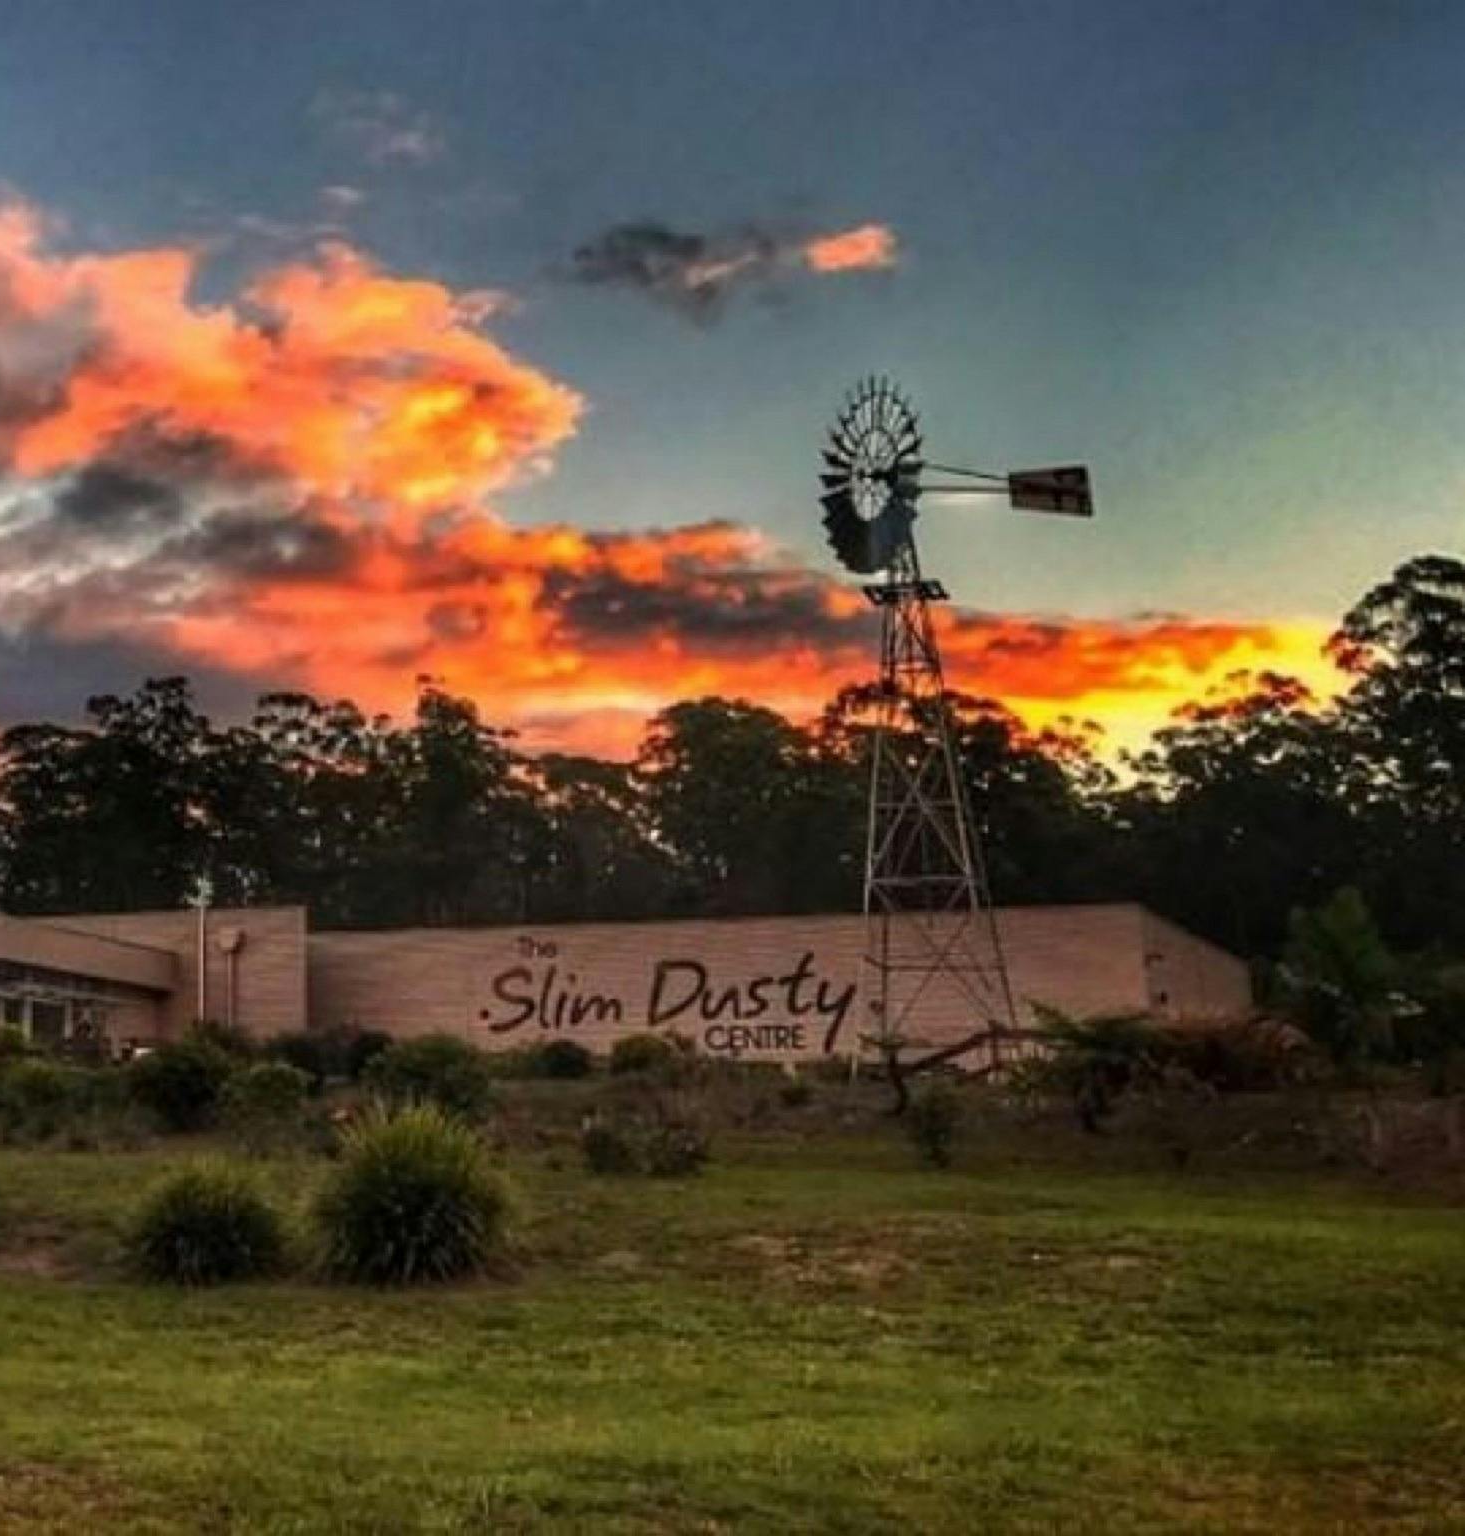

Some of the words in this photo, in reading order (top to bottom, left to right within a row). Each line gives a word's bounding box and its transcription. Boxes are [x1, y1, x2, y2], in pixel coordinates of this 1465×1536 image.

[488, 965, 622, 1032] Slim
[647, 952, 857, 1053] Dusty
[704, 1025, 808, 1051] CENTRE
